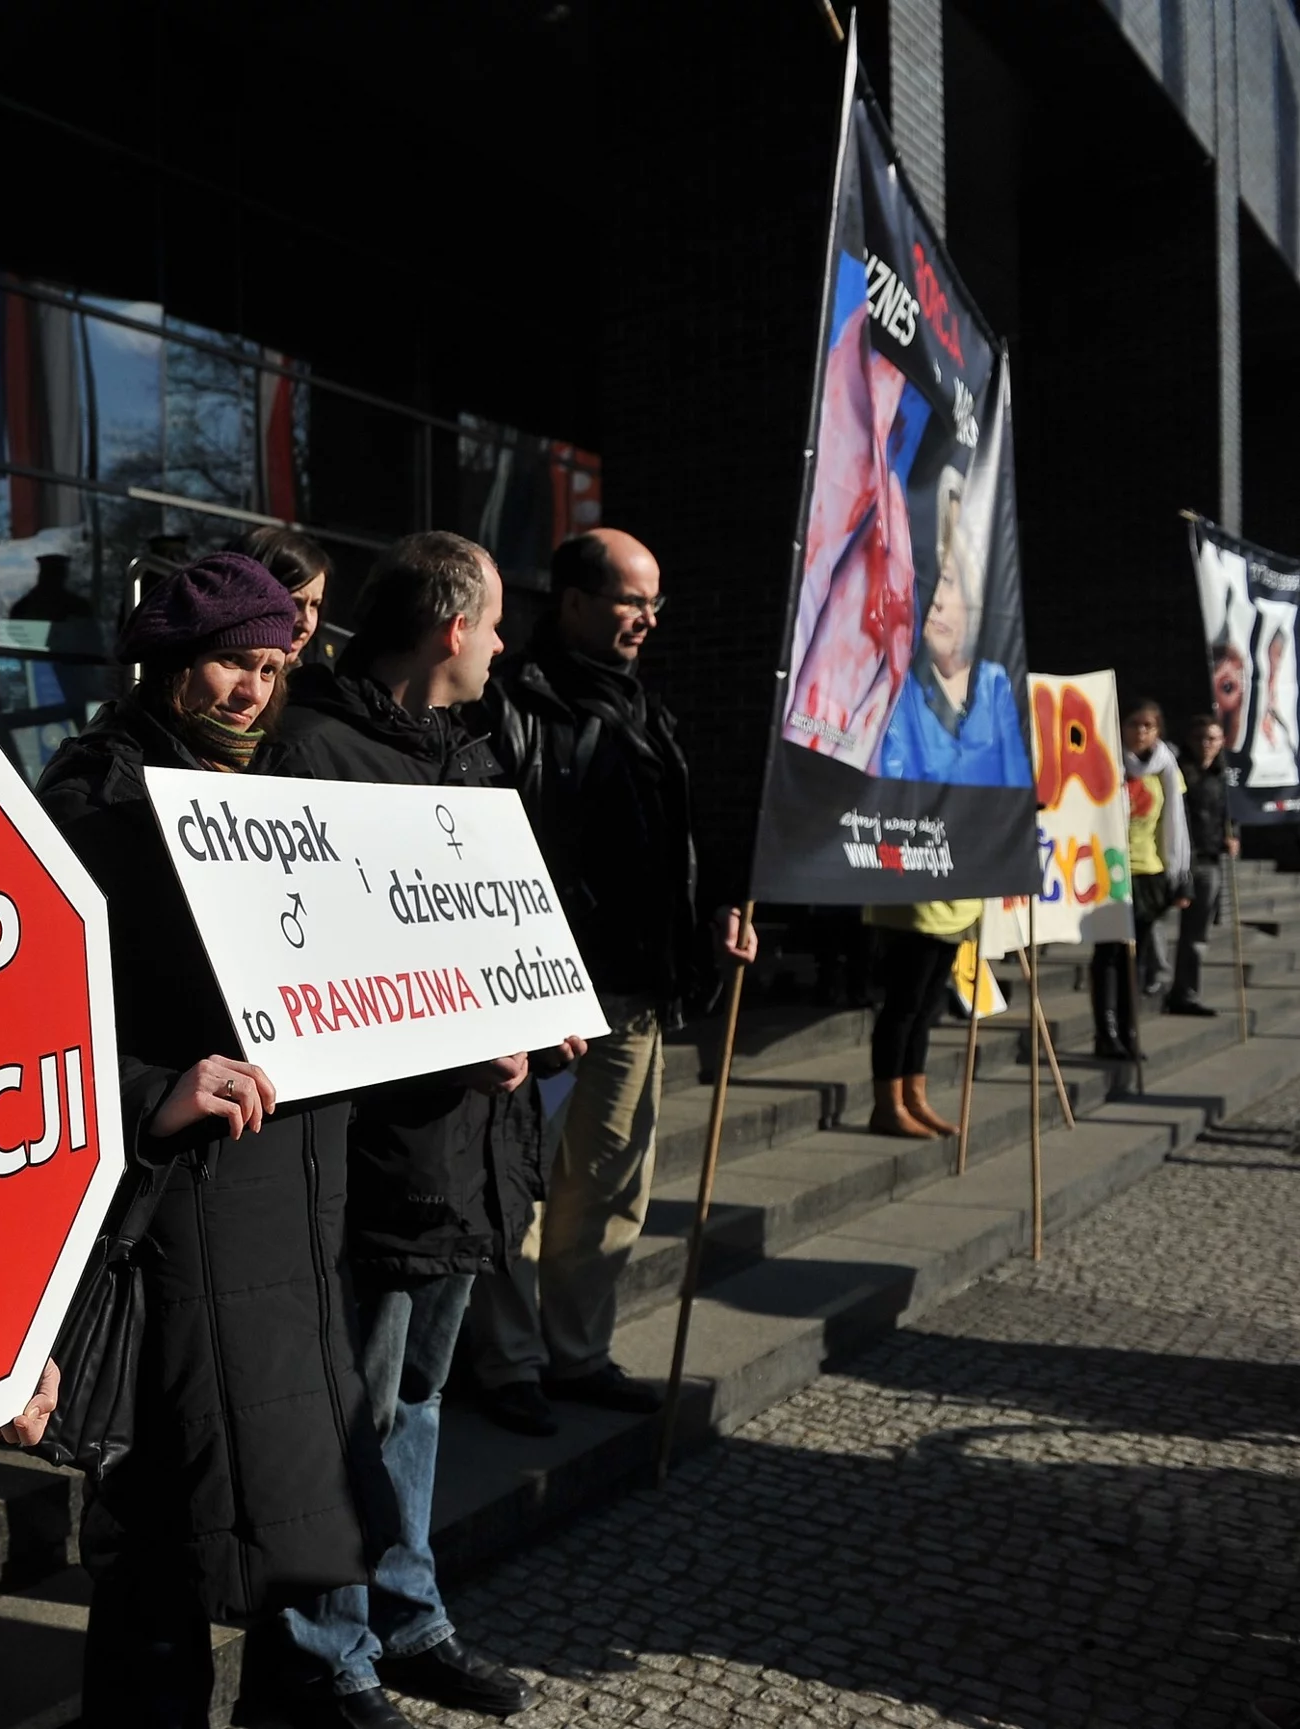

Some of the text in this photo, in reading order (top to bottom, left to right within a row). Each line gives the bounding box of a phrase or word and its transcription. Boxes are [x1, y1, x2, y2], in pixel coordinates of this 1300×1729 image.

[864, 247, 921, 347] IZNES
[177, 799, 342, 875] chłopak
[355, 857, 554, 927] i dziewczyna
[241, 947, 586, 1044] to PRAWDZIWA rodzina
